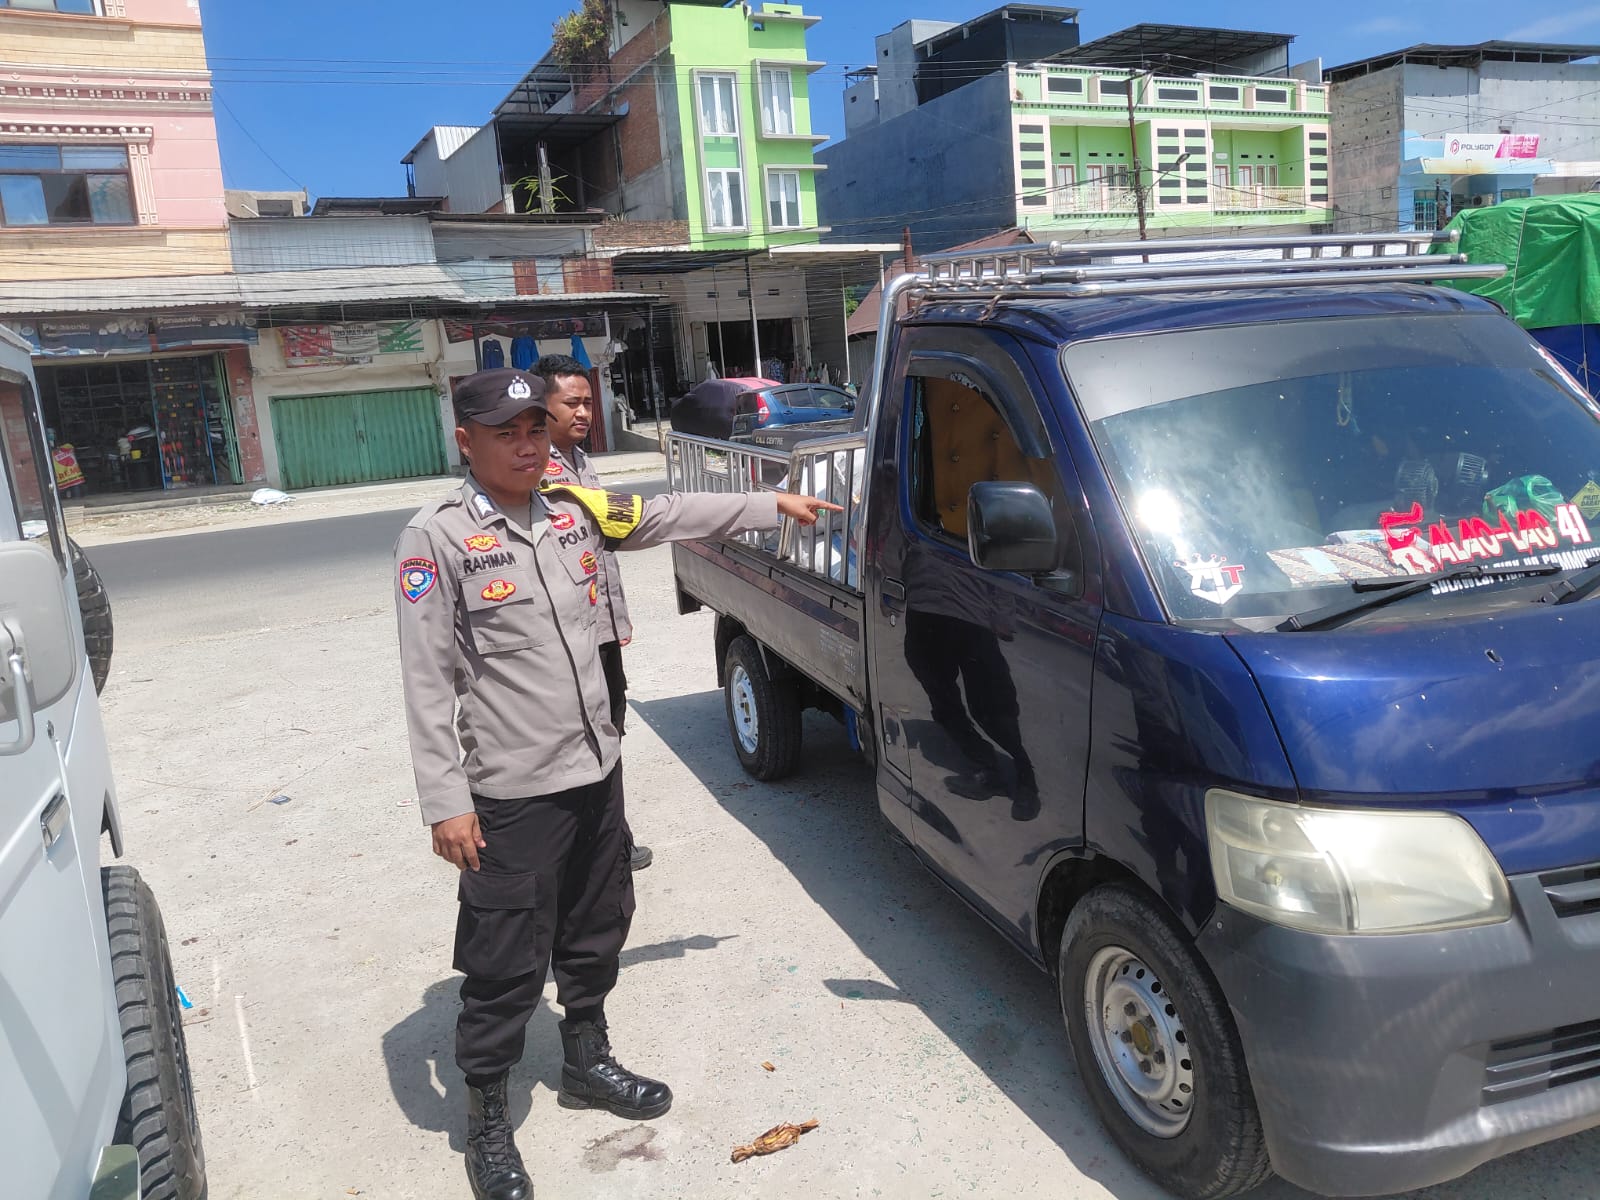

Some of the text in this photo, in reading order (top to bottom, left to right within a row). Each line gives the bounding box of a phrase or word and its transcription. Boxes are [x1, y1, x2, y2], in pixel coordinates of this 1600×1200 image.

[1461, 143, 1494, 151] POLYGON
[157, 315, 201, 325] Panasonic
[1555, 503, 1593, 545] 41
[463, 551, 517, 574] RAHMAN
